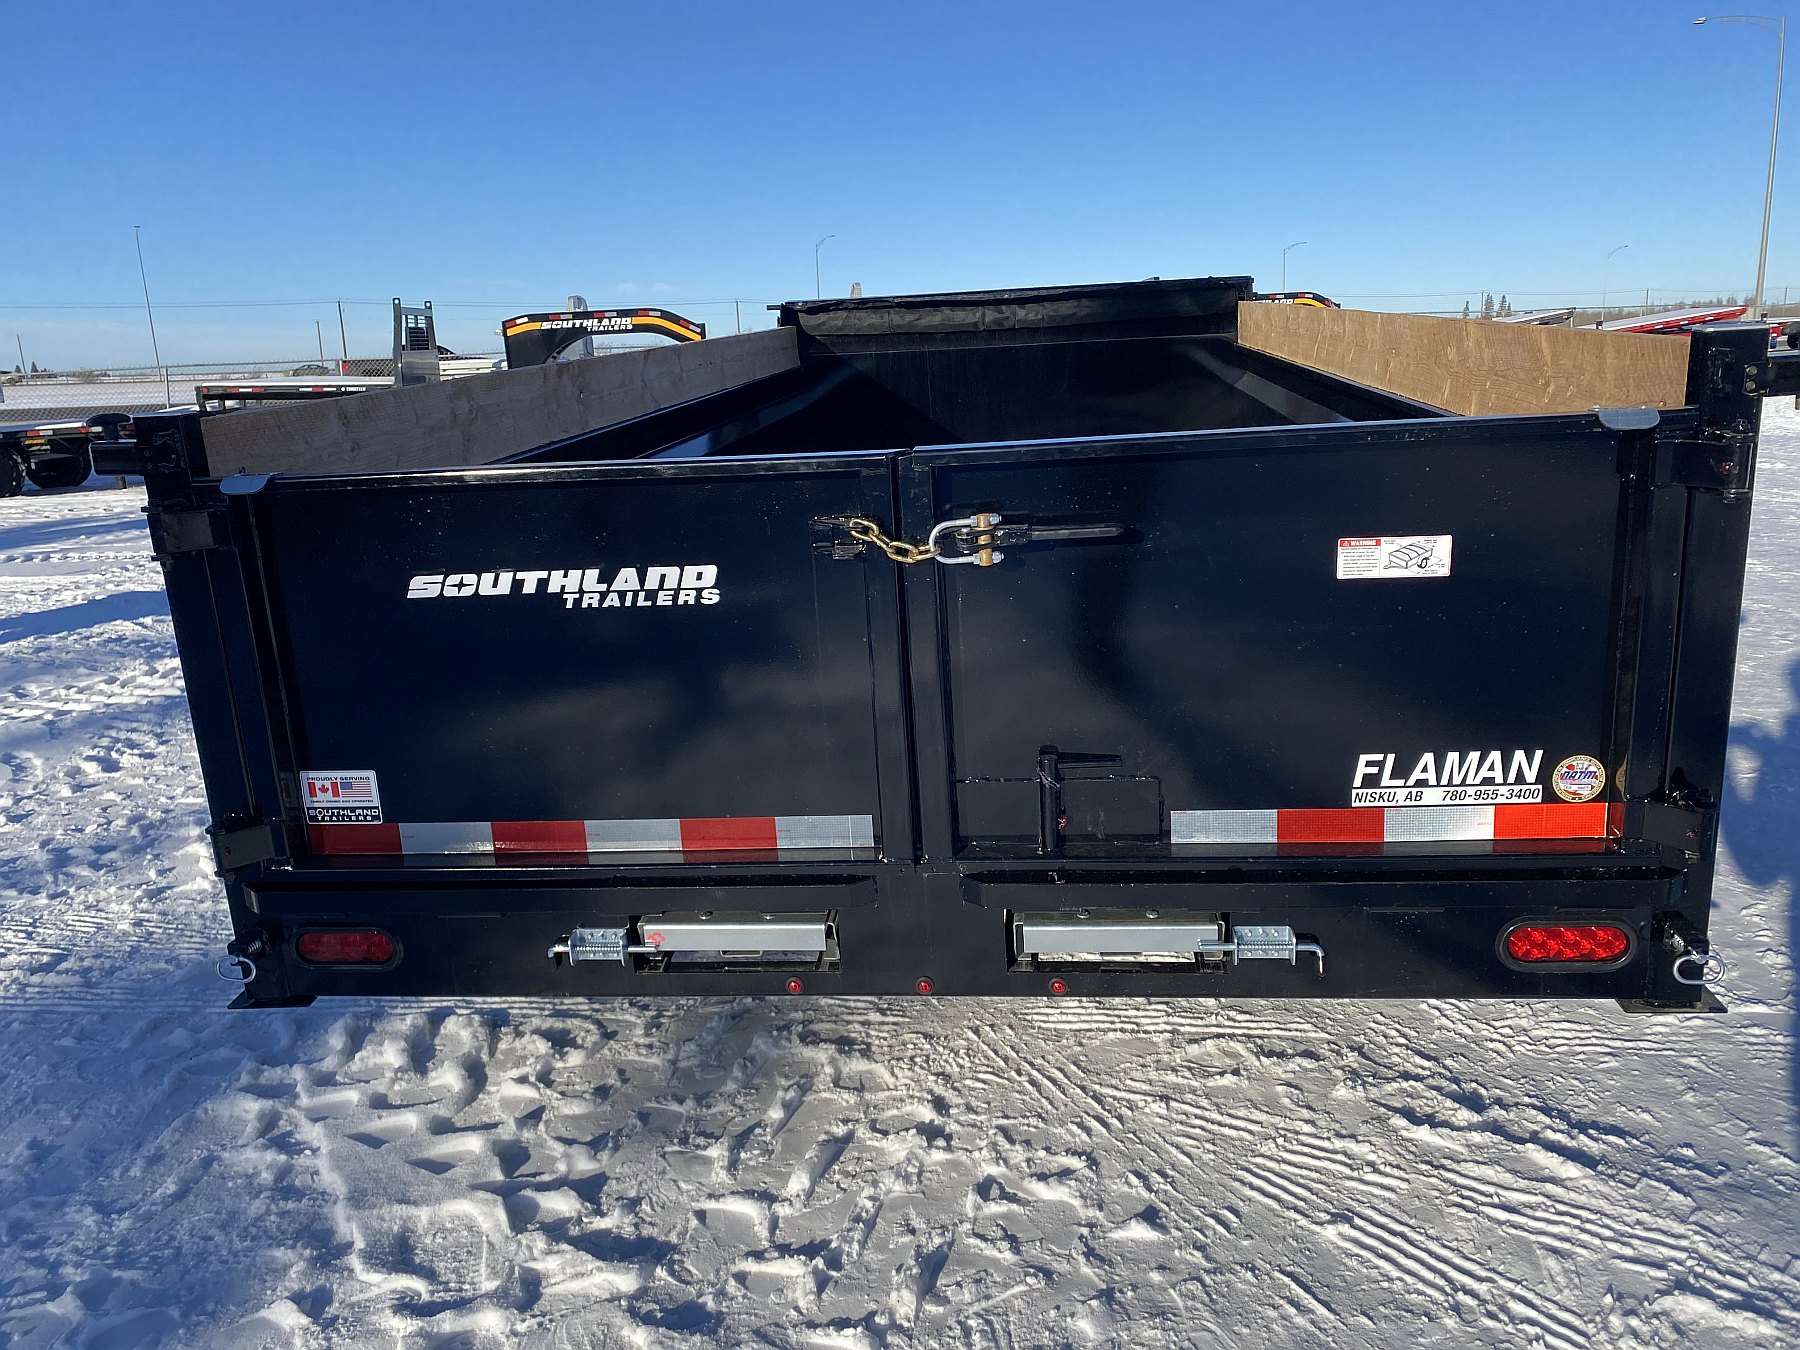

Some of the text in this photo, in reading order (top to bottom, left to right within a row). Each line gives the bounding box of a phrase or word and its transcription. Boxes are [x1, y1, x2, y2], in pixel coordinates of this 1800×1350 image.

[541, 317, 633, 330] SOUTHLAND
[587, 324, 633, 332] TRAILERS
[407, 564, 718, 599] SOUTHLAND
[562, 588, 721, 609] TRAILERS
[1352, 749, 1544, 788] FLAMAN
[1354, 791, 1400, 805] NISKU,
[1403, 790, 1424, 802] AB
[1441, 788, 1540, 802] 780-955-3400
[308, 808, 379, 817] SOUTHLAND
